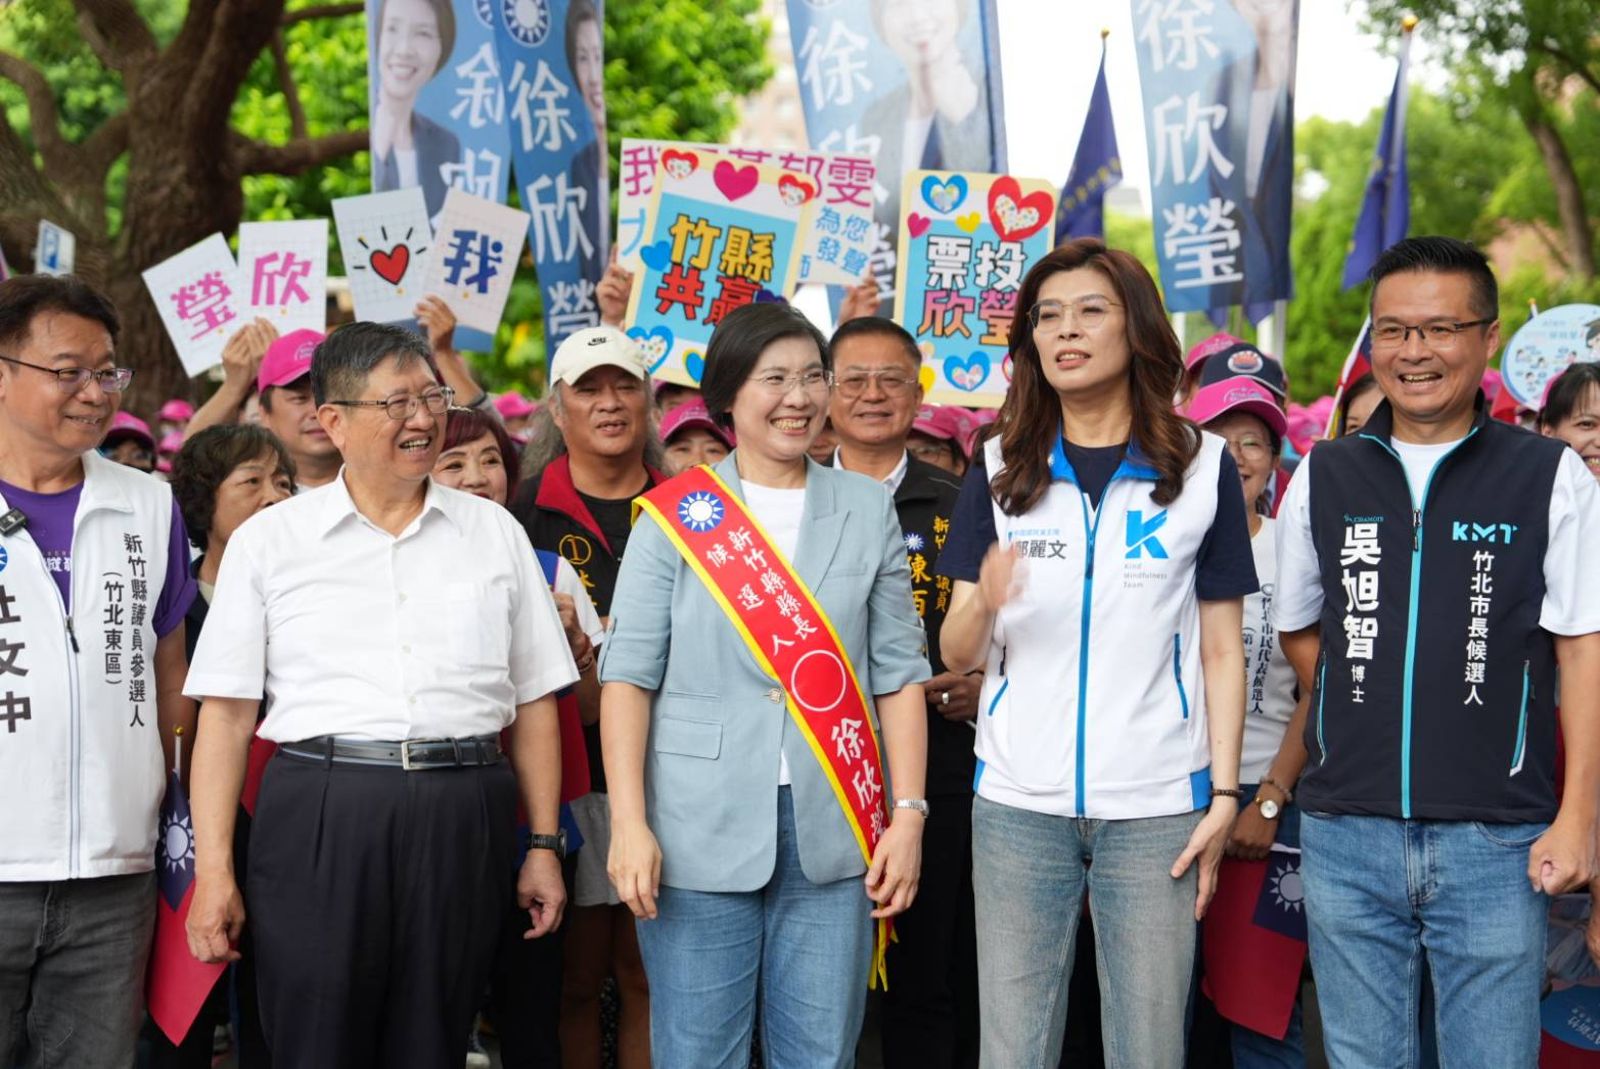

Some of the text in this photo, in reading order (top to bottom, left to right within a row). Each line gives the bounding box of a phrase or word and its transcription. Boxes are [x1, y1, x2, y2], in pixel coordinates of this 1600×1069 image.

[1137, 0, 1243, 289] 徐欣瑩
[669, 213, 776, 283] 竹縣
[815, 206, 872, 244] 為您
[815, 237, 868, 277] 發聲
[251, 252, 312, 307] 欣
[444, 229, 503, 294] 我
[926, 234, 1028, 291] 票投
[170, 271, 237, 341] 瑩
[917, 290, 1017, 347] 欣瑩
[1125, 508, 1169, 559] K
[1452, 521, 1519, 544] KMT
[706, 544, 795, 656] 候選人
[728, 526, 818, 640] 新竹縣縣長
[1339, 523, 1382, 660] 吳旭智
[103, 571, 124, 686] （竹北東區）
[123, 533, 148, 728] 新竹縣議員參選人
[1464, 550, 1495, 706] 竹北市長候選人
[1351, 664, 1366, 703] 博士
